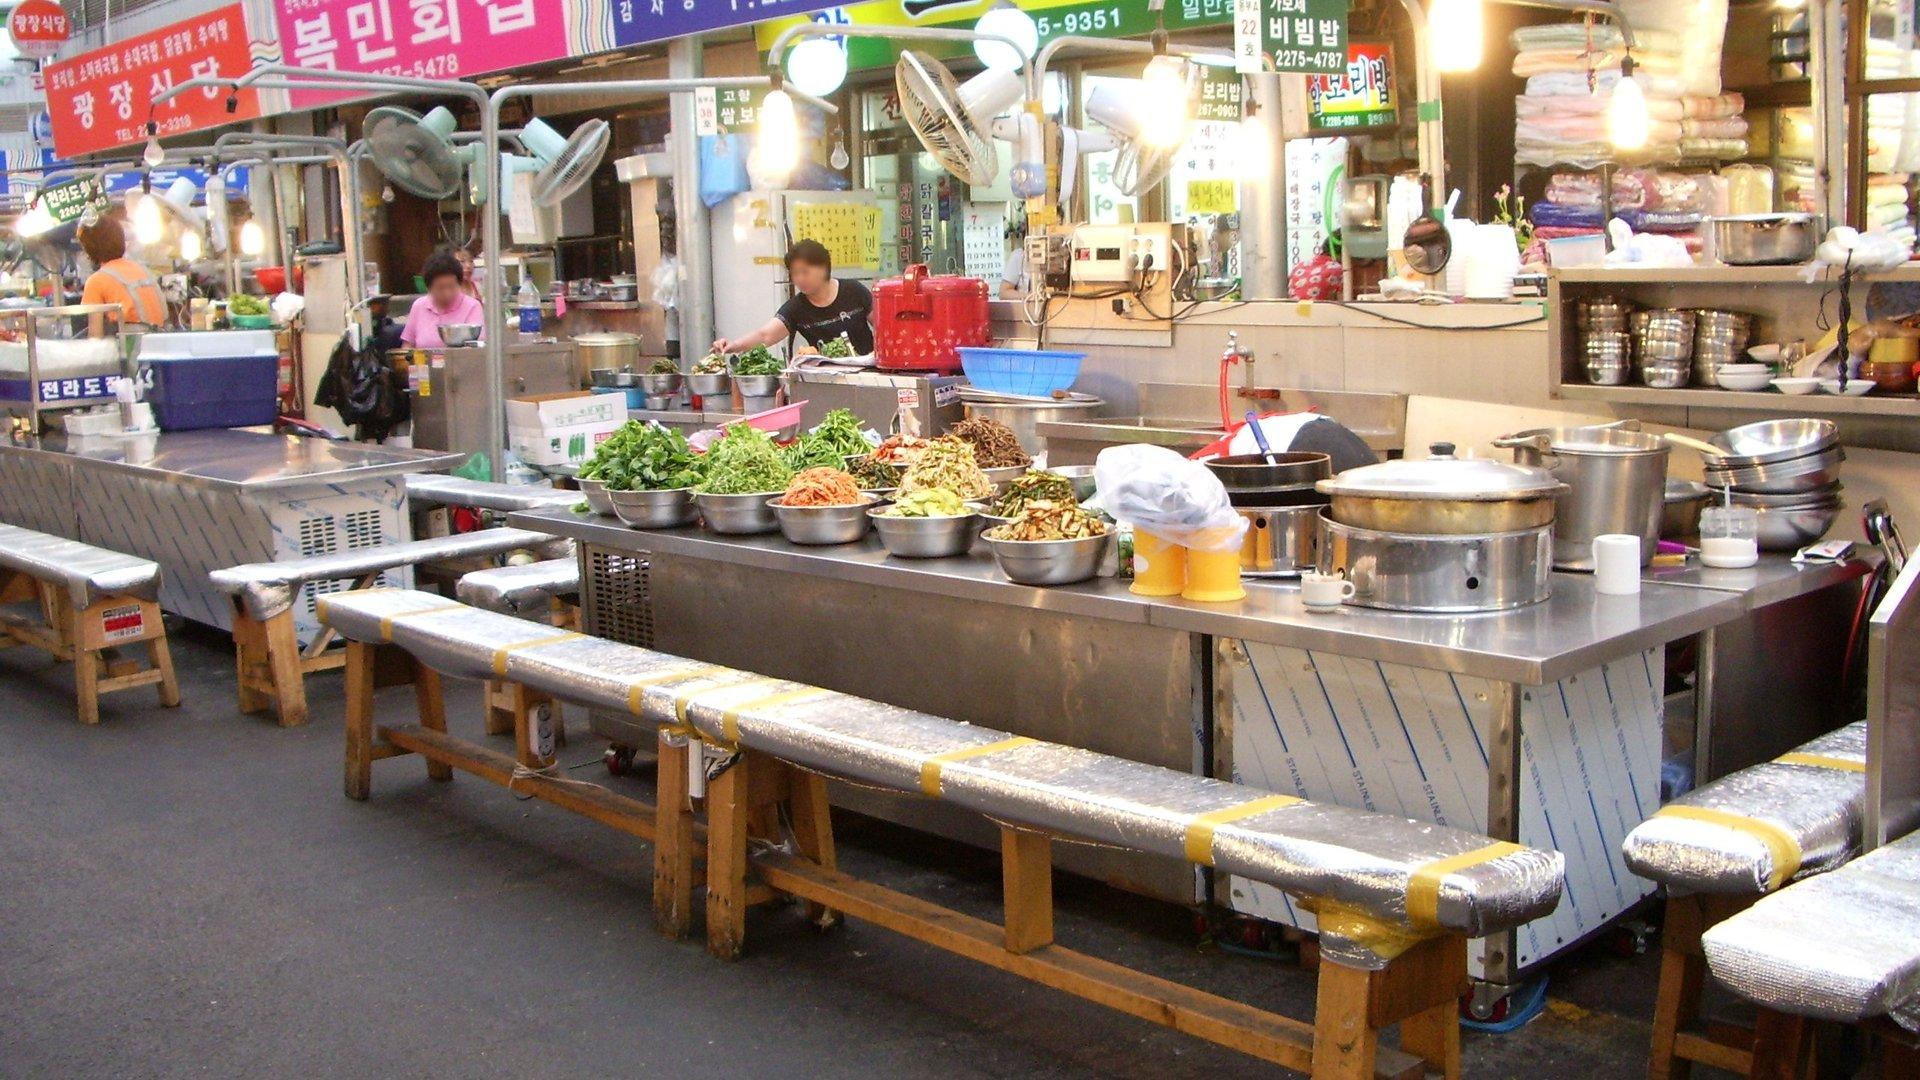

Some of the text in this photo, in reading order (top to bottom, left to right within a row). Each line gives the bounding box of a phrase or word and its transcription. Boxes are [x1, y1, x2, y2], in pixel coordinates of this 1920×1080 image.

[1038, 8, 1121, 35] 5-9351
[1242, 19, 1256, 35] 22
[1269, 16, 1340, 47] 비빔밥
[372, 53, 459, 78] 7-5478
[1275, 49, 1343, 69] 2275-4787
[73, 56, 220, 130] 광장식당
[1202, 80, 1241, 102] 보리밥
[700, 108, 713, 118] 38
[115, 128, 133, 141] TEL
[920, 183, 934, 262] 닭칼국수
[1286, 757, 1309, 801] STAINLES
[1352, 769, 1377, 813] STAINLES
[1423, 783, 1448, 827] STAINLES
